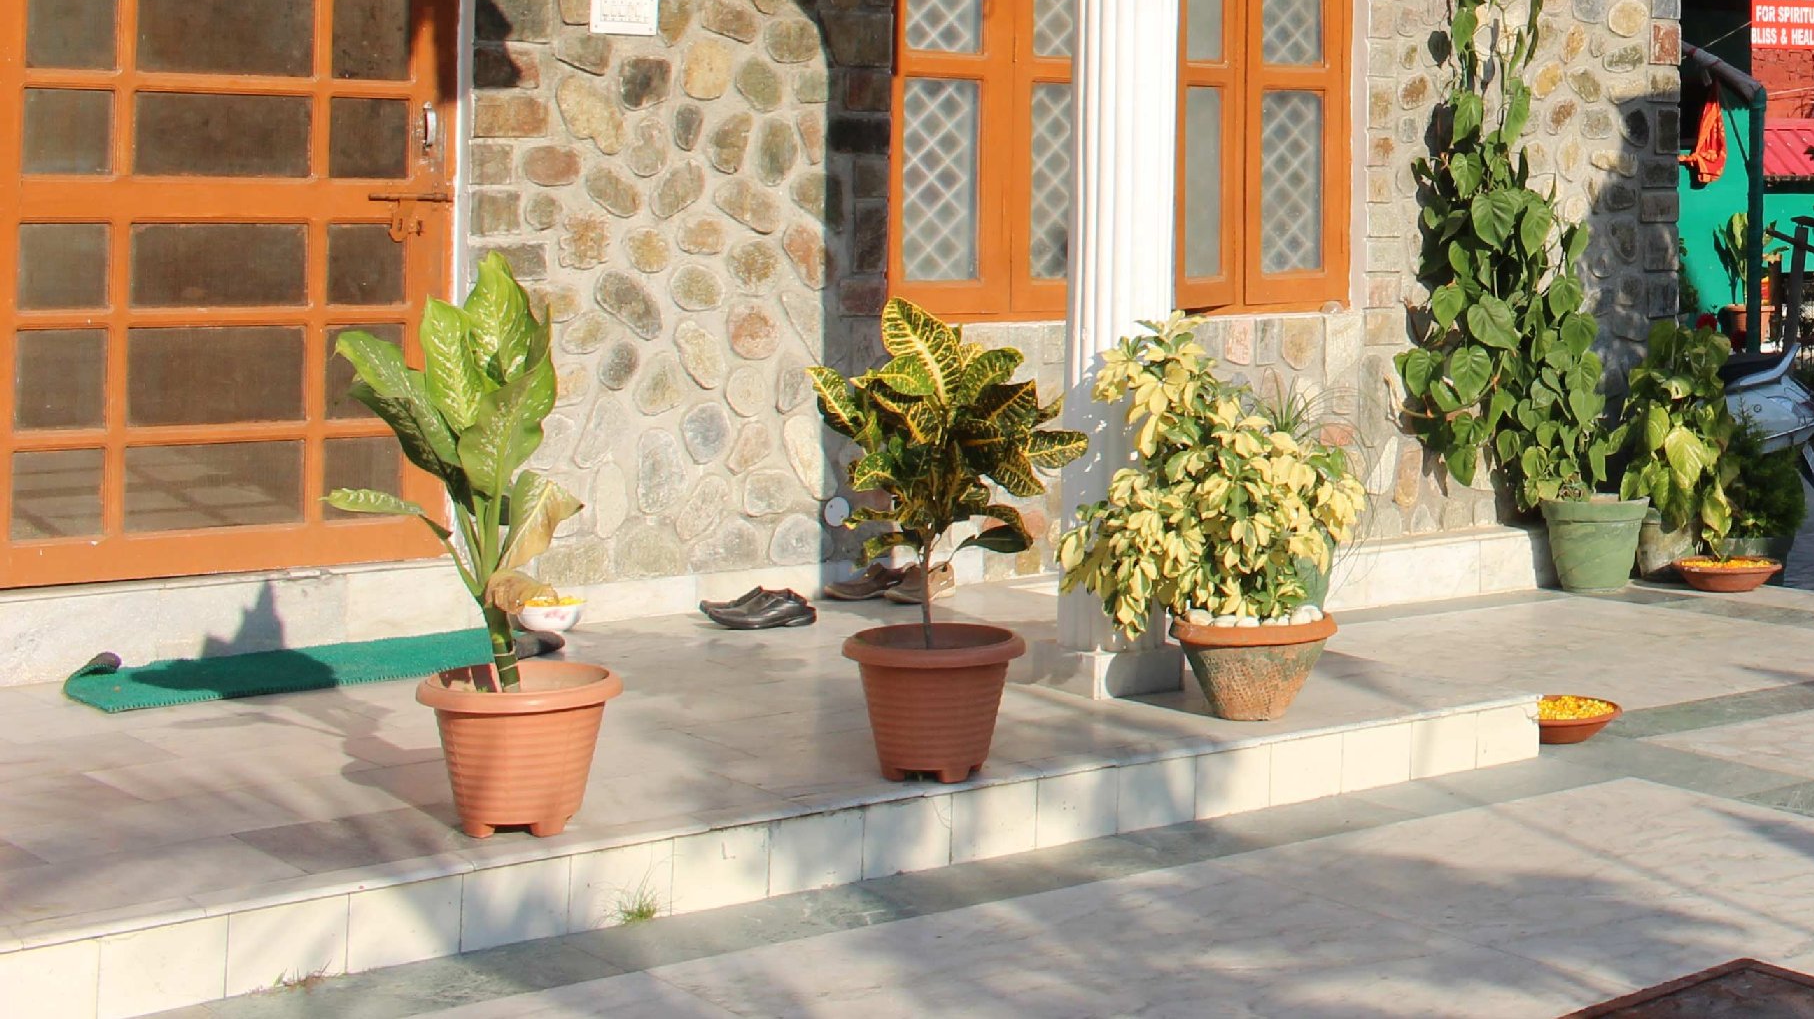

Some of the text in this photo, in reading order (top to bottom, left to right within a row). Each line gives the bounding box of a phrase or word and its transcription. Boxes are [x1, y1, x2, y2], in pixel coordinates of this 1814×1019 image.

[1755, 5, 1776, 22] FOR
[1751, 27, 1777, 45] BLISS
[1780, 28, 1788, 45] &
